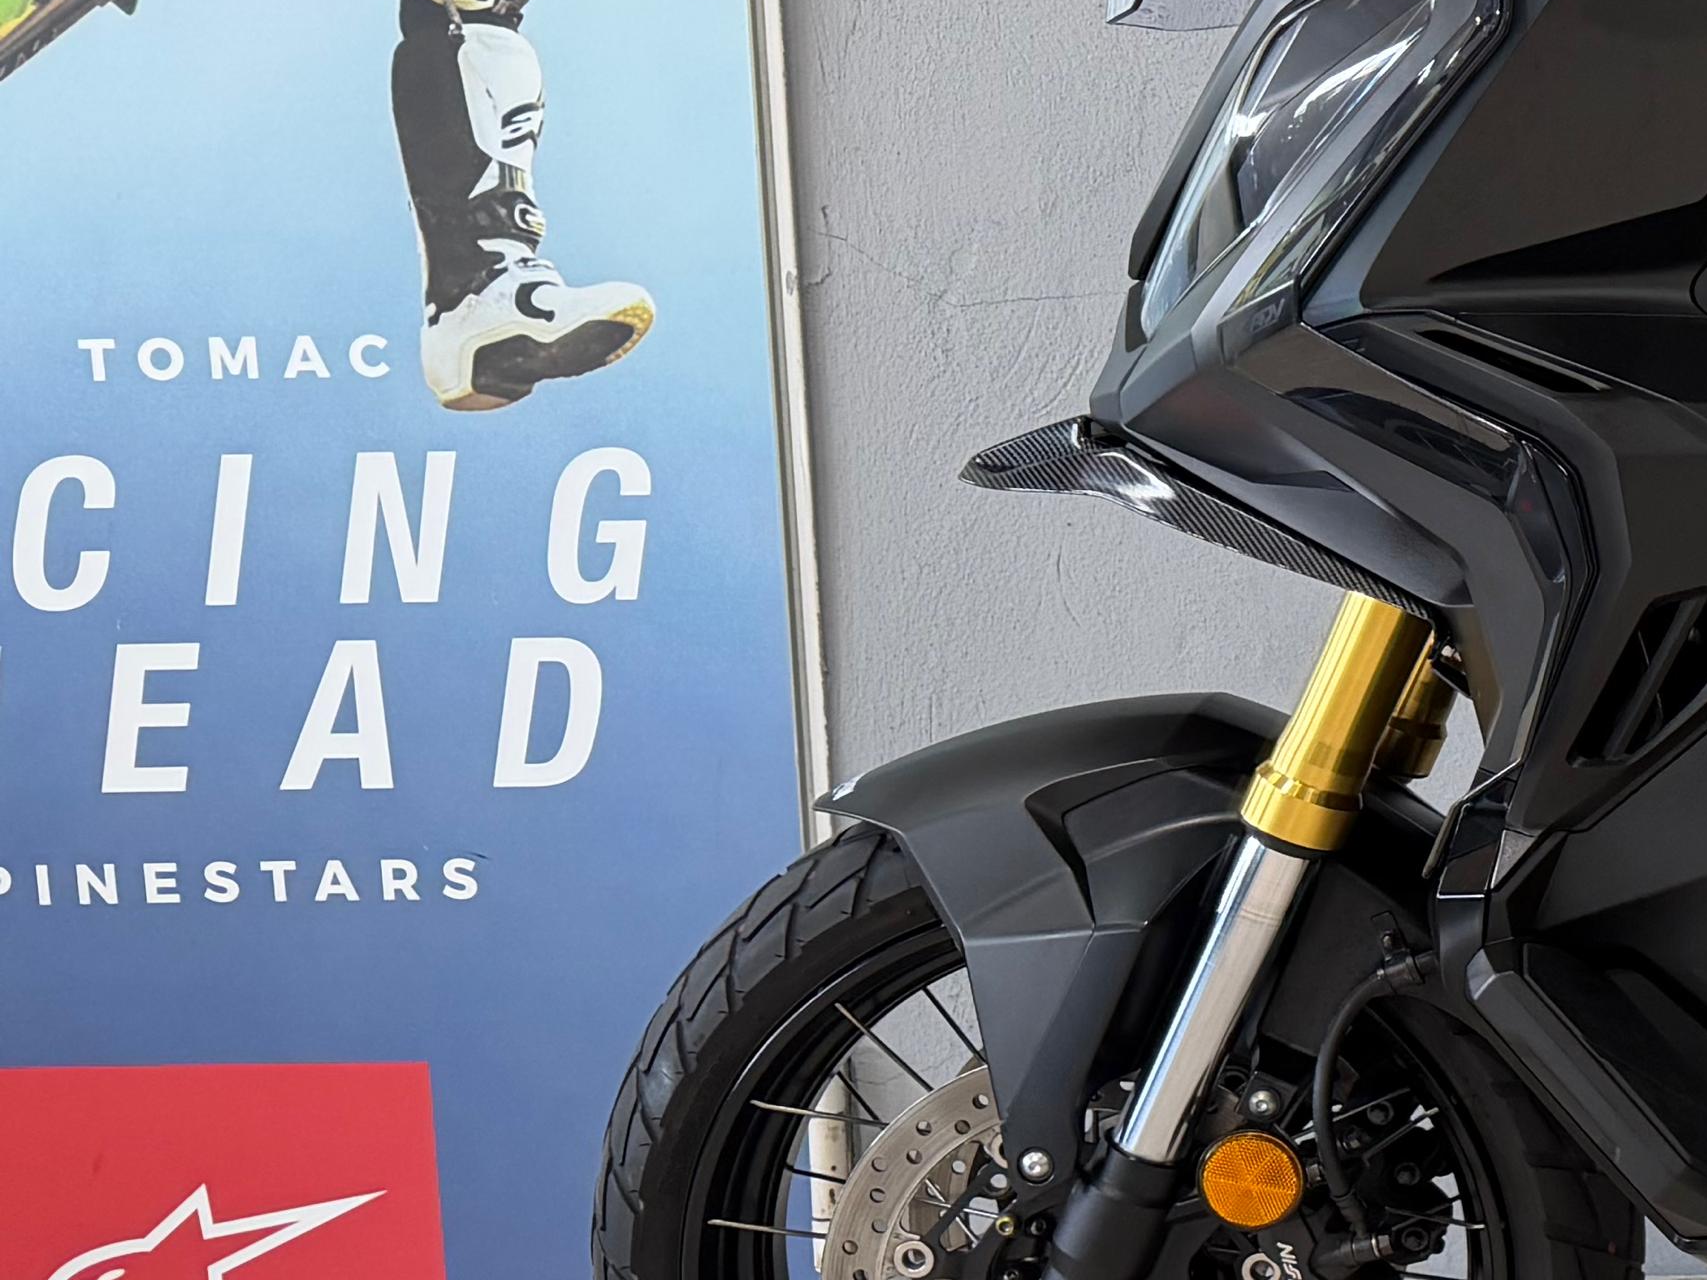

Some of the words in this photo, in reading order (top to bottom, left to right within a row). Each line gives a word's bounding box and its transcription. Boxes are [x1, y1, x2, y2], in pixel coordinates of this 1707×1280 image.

[77, 334, 391, 383] TOMAC
[12, 446, 653, 612] CING
[0, 637, 604, 794] EAD
